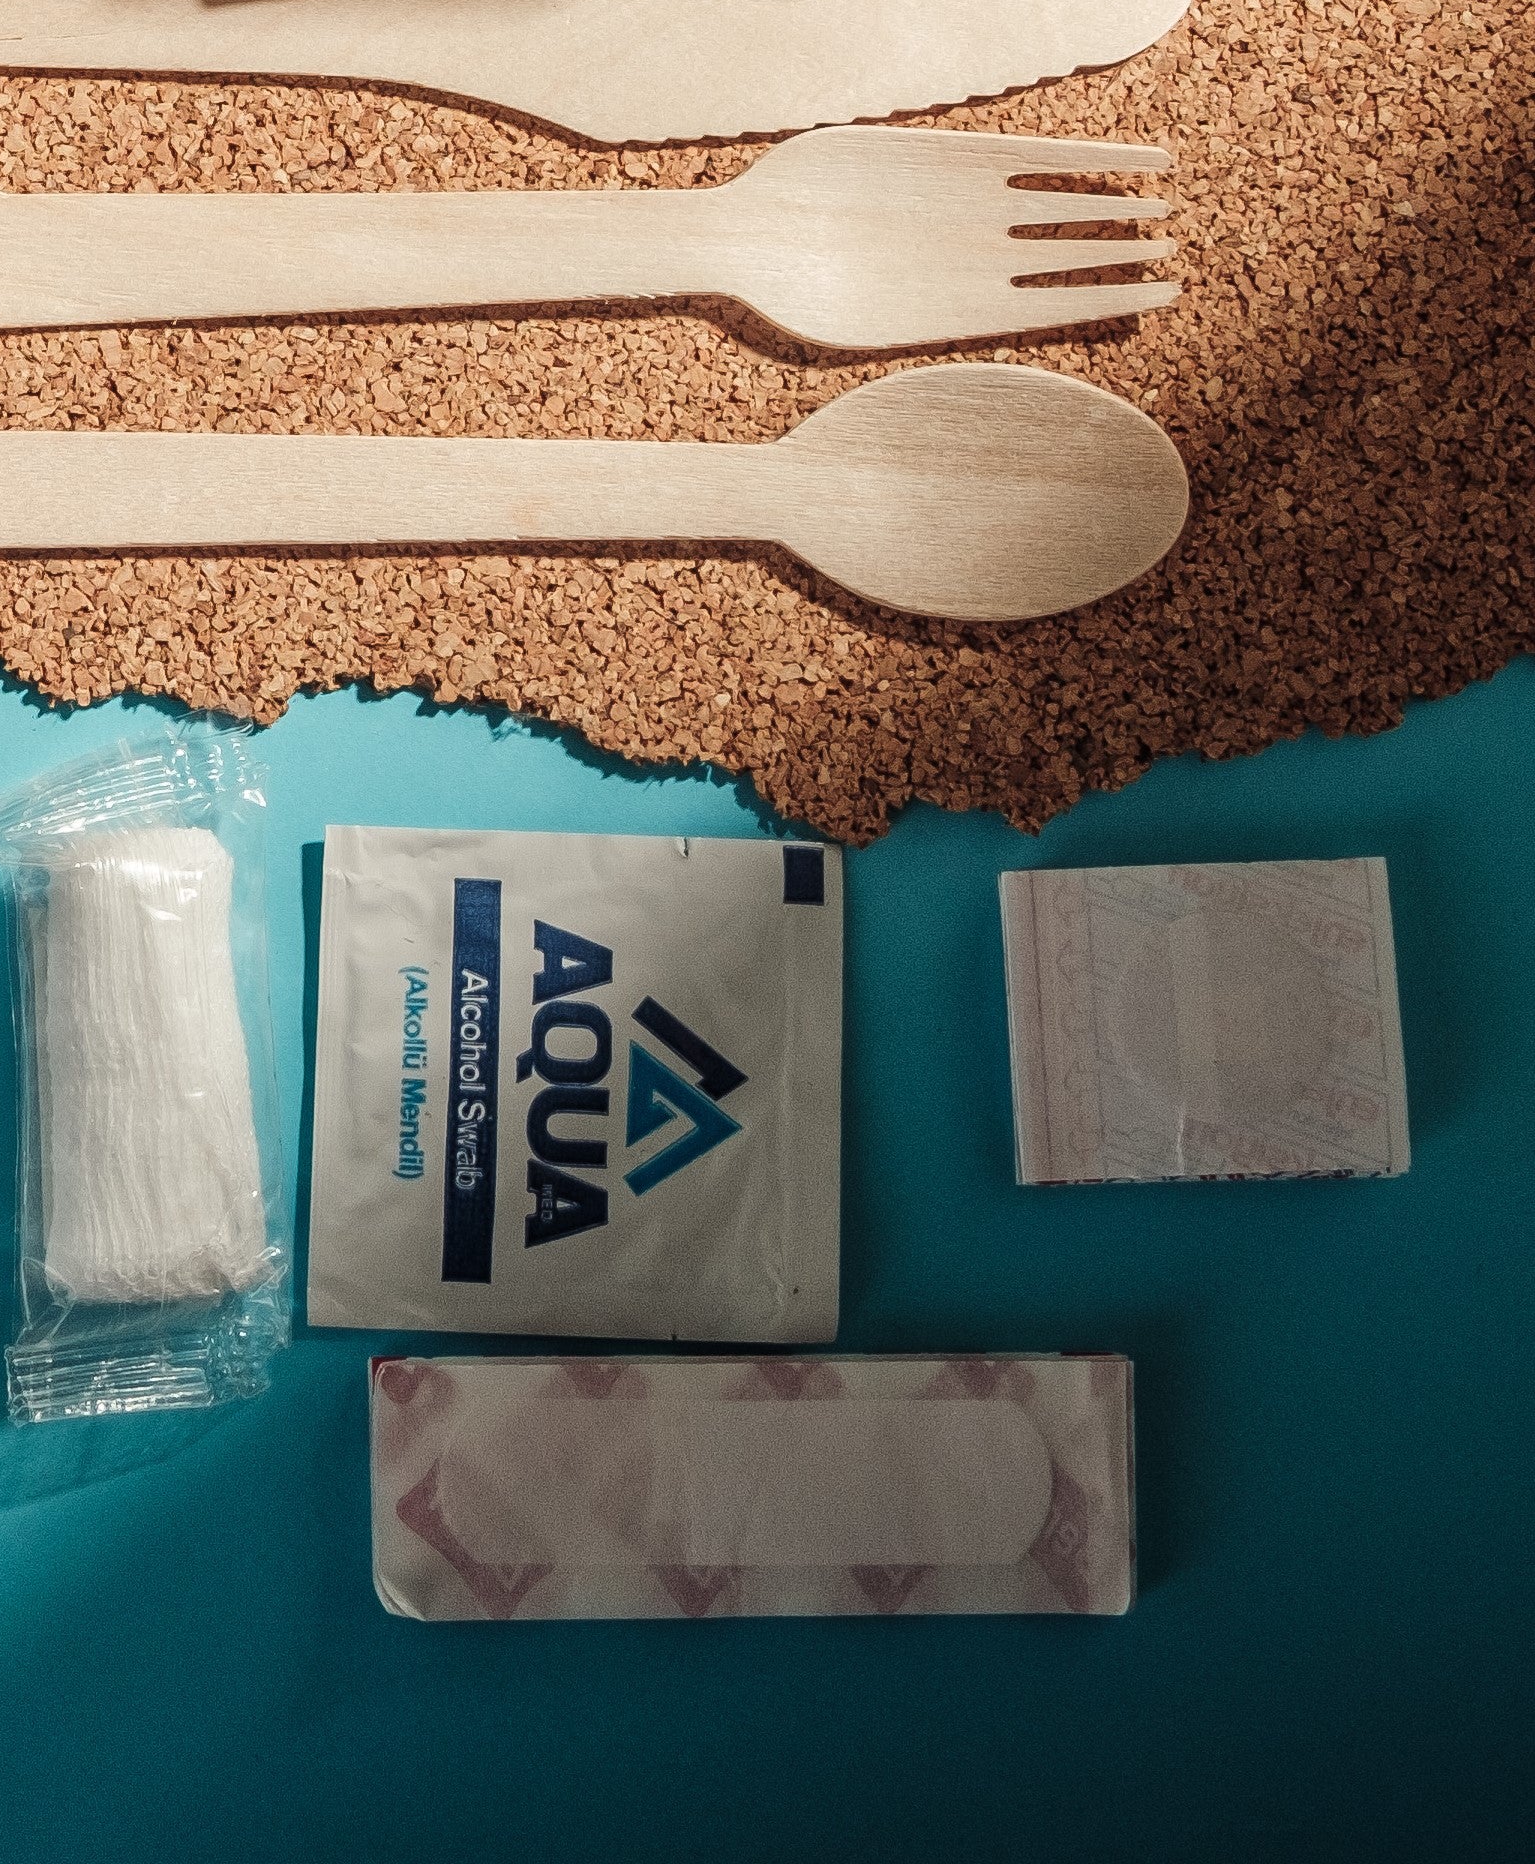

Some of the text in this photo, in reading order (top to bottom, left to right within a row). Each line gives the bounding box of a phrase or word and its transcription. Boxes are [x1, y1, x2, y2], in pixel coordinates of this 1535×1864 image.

[392, 965, 429, 1180] (Alkollü Mendil)
[455, 967, 489, 1190] Alcohol Swab
[516, 919, 614, 1249] AQUA
